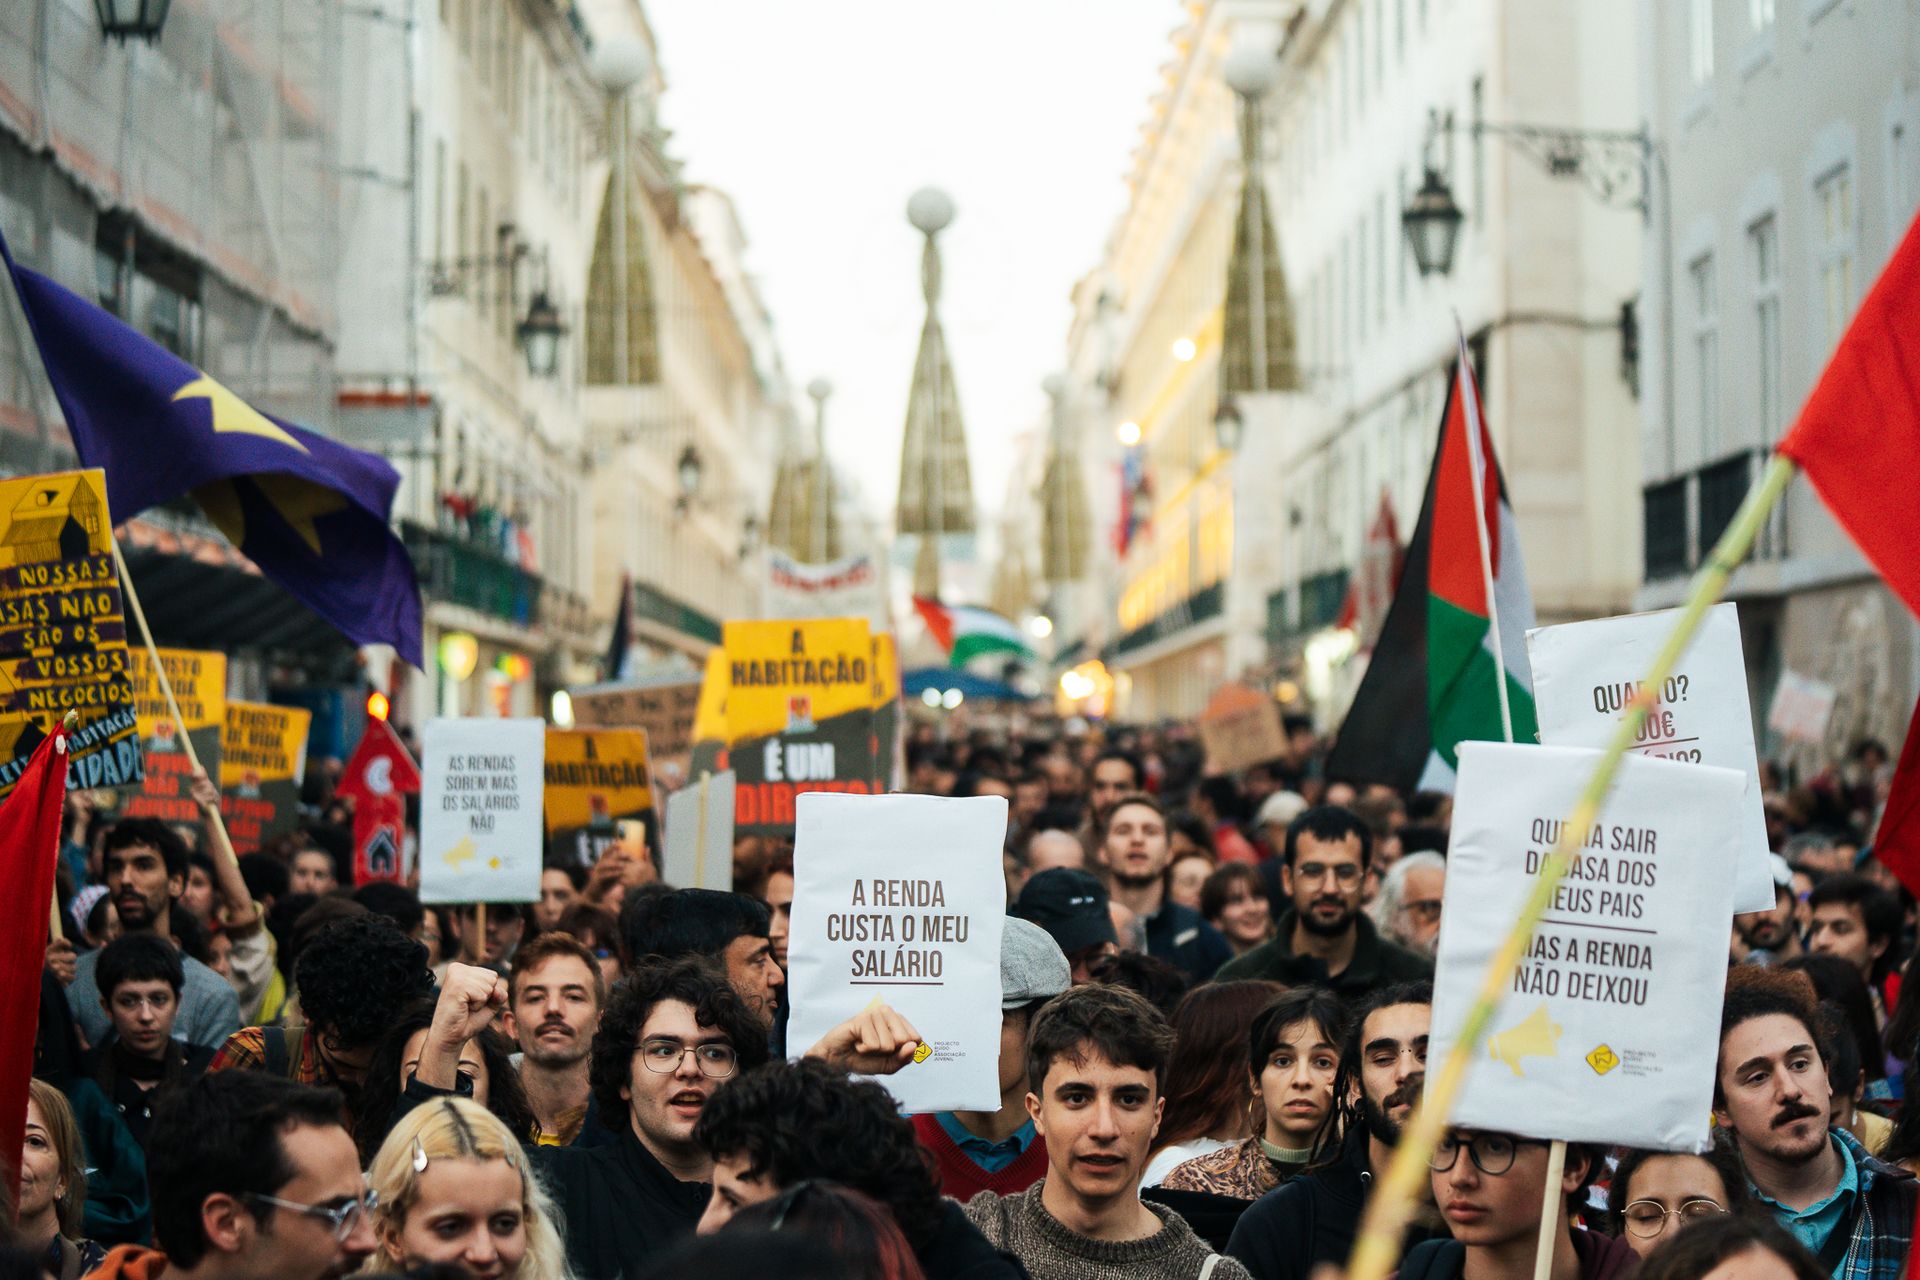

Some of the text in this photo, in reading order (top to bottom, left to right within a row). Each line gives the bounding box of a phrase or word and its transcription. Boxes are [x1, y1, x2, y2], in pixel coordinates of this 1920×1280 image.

[19, 558, 110, 586] NOSSAS
[74, 624, 100, 645] OS
[791, 629, 804, 654] A
[37, 651, 123, 677] VOSSOS
[731, 654, 866, 690] HABITAÇÃO
[449, 755, 516, 773] AS RENDAS
[764, 737, 836, 782] É UM
[445, 775, 518, 792] SOBEM MAS
[443, 795, 459, 812] OS
[1610, 826, 1657, 855] SAIR
[1616, 860, 1657, 887] DOS
[851, 879, 946, 907] A RENDA
[1599, 890, 1645, 919] PAIS
[827, 913, 969, 943] CUSTA O MEU
[851, 944, 943, 978] SALÁRIO
[1566, 938, 1579, 963] A
[1585, 940, 1653, 971] RENDA
[1514, 961, 1649, 1007] NÃO DEIXOU
